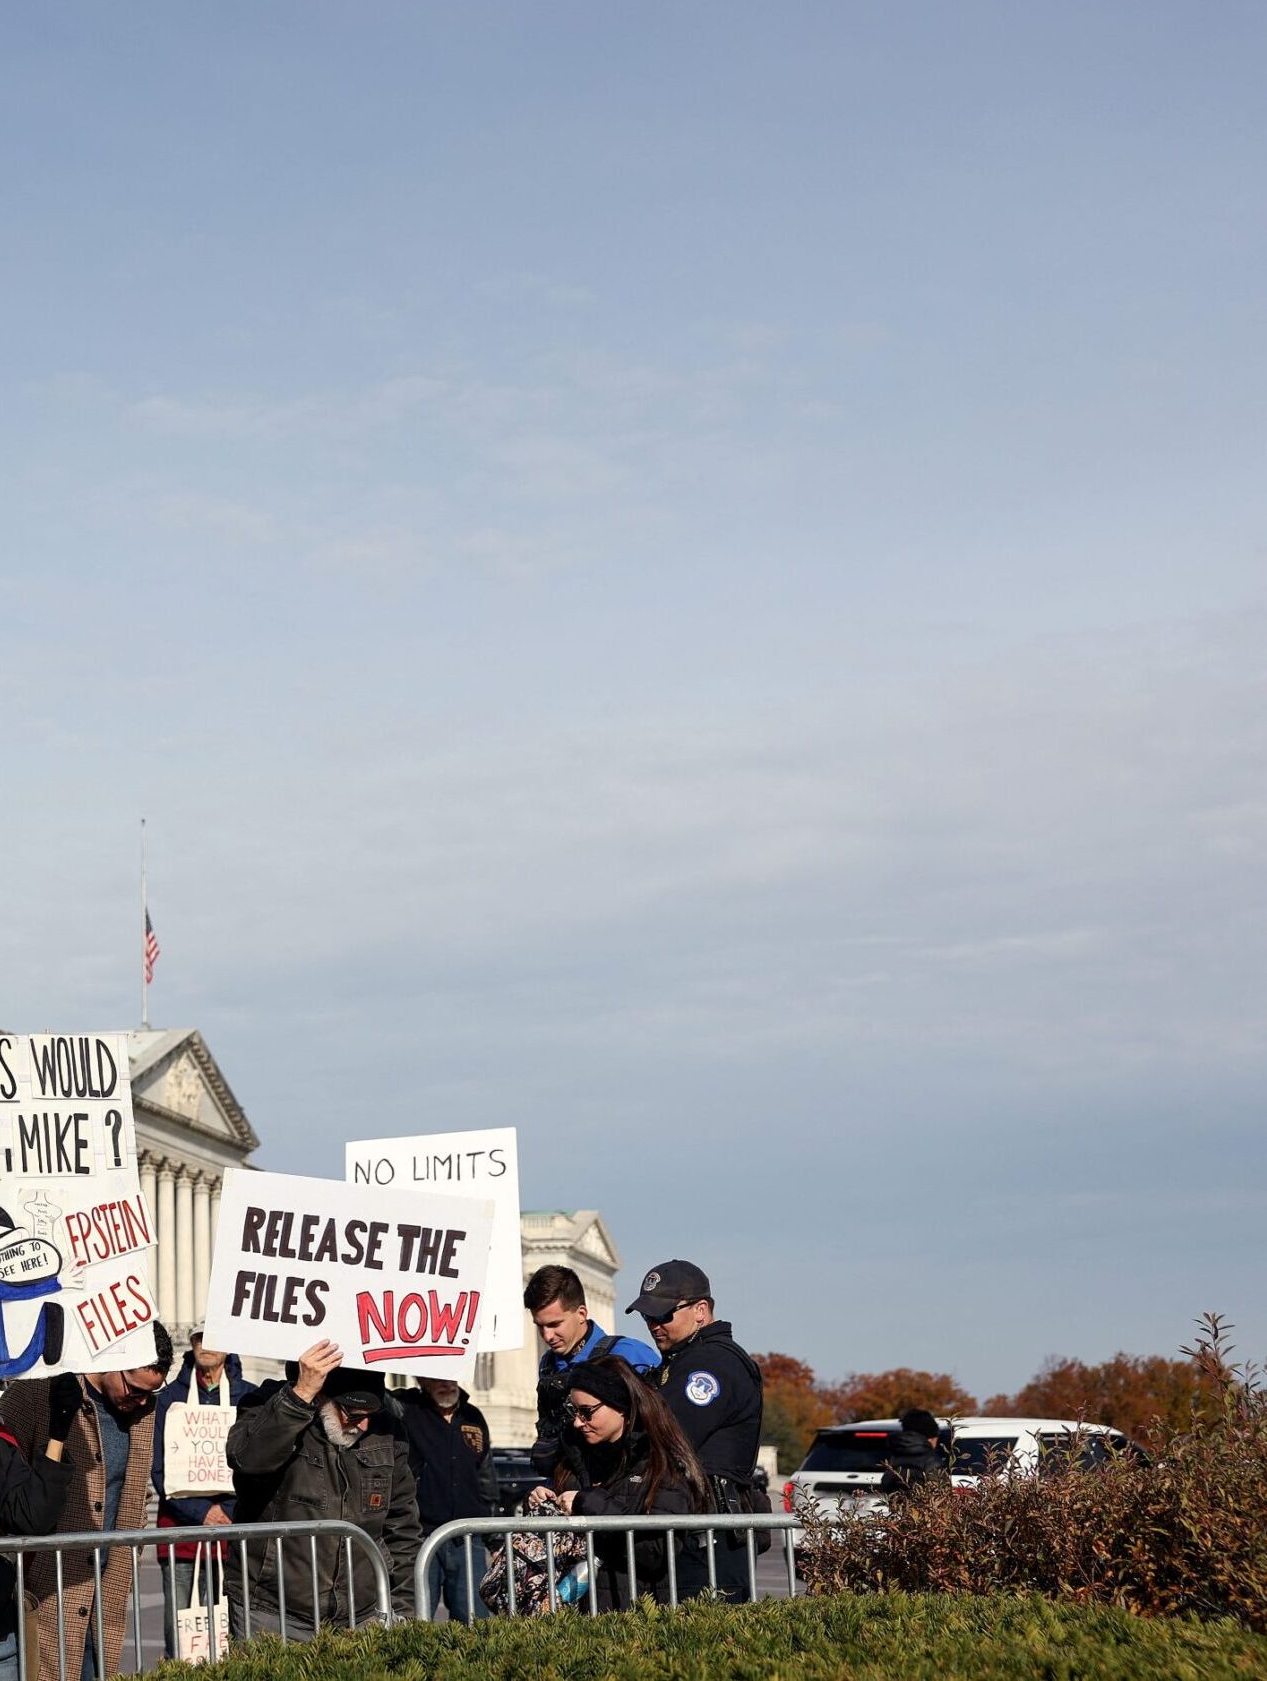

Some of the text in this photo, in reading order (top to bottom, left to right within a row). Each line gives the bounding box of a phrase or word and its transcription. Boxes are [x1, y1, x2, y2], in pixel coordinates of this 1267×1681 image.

[30, 1037, 118, 1099] WOULD
[354, 1149, 507, 1185] NO LIMITS
[65, 1195, 151, 1267] EPSTEIN
[241, 1206, 467, 1279] RELEASE THE
[29, 1241, 41, 1252] TO
[77, 1275, 152, 1351] FILES
[231, 1270, 330, 1327] FILES
[355, 1289, 480, 1345] NOW!
[184, 1411, 230, 1425] WHAT
[183, 1426, 230, 1439] WOUL
[191, 1440, 226, 1455] YOU
[188, 1454, 225, 1469] HAVE
[188, 1468, 232, 1483] DONE?
